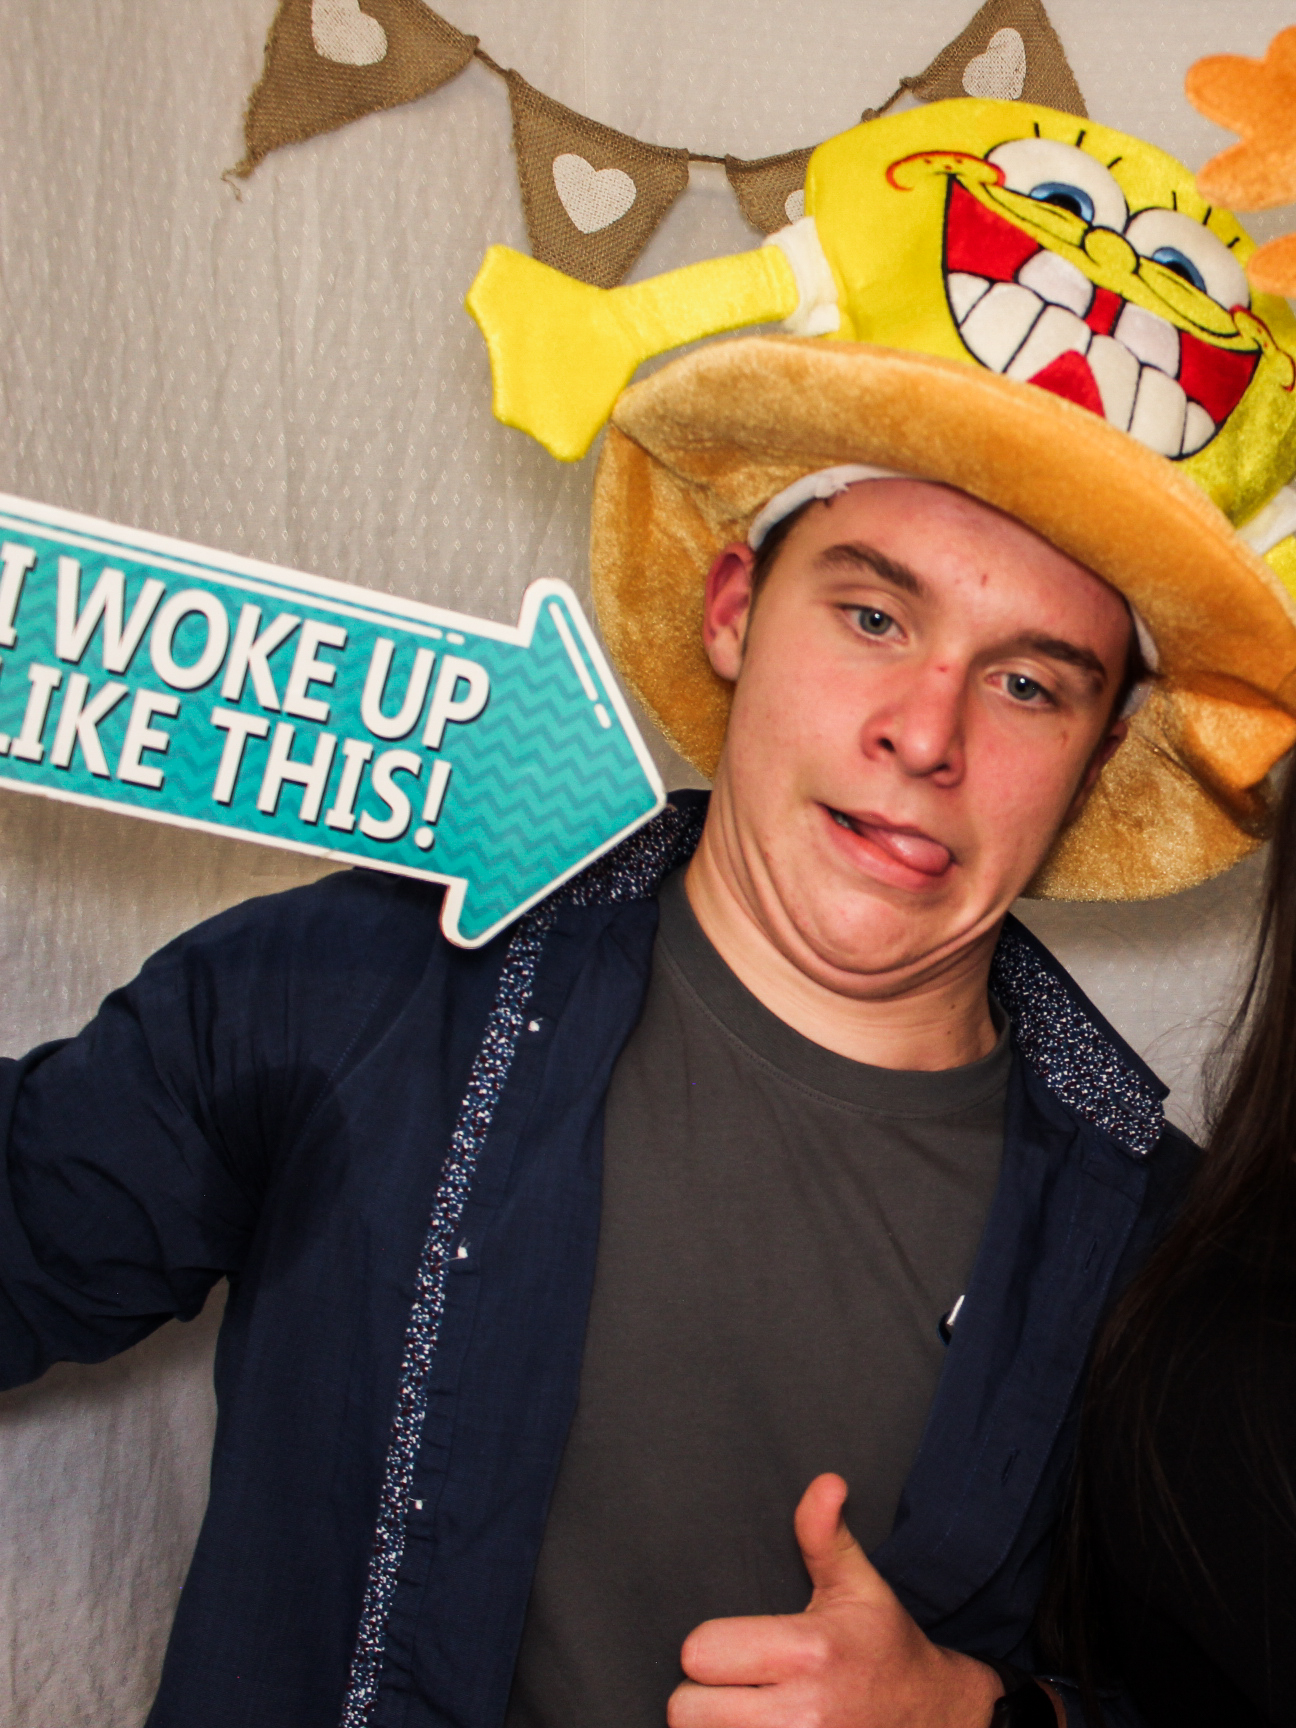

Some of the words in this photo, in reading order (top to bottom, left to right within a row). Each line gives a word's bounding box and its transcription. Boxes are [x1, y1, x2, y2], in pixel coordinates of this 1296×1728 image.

[0, 541, 37, 650] I
[55, 554, 348, 723] WOKE
[360, 638, 491, 751] UP
[0, 655, 181, 792] IKE
[209, 706, 453, 850] THIS!
